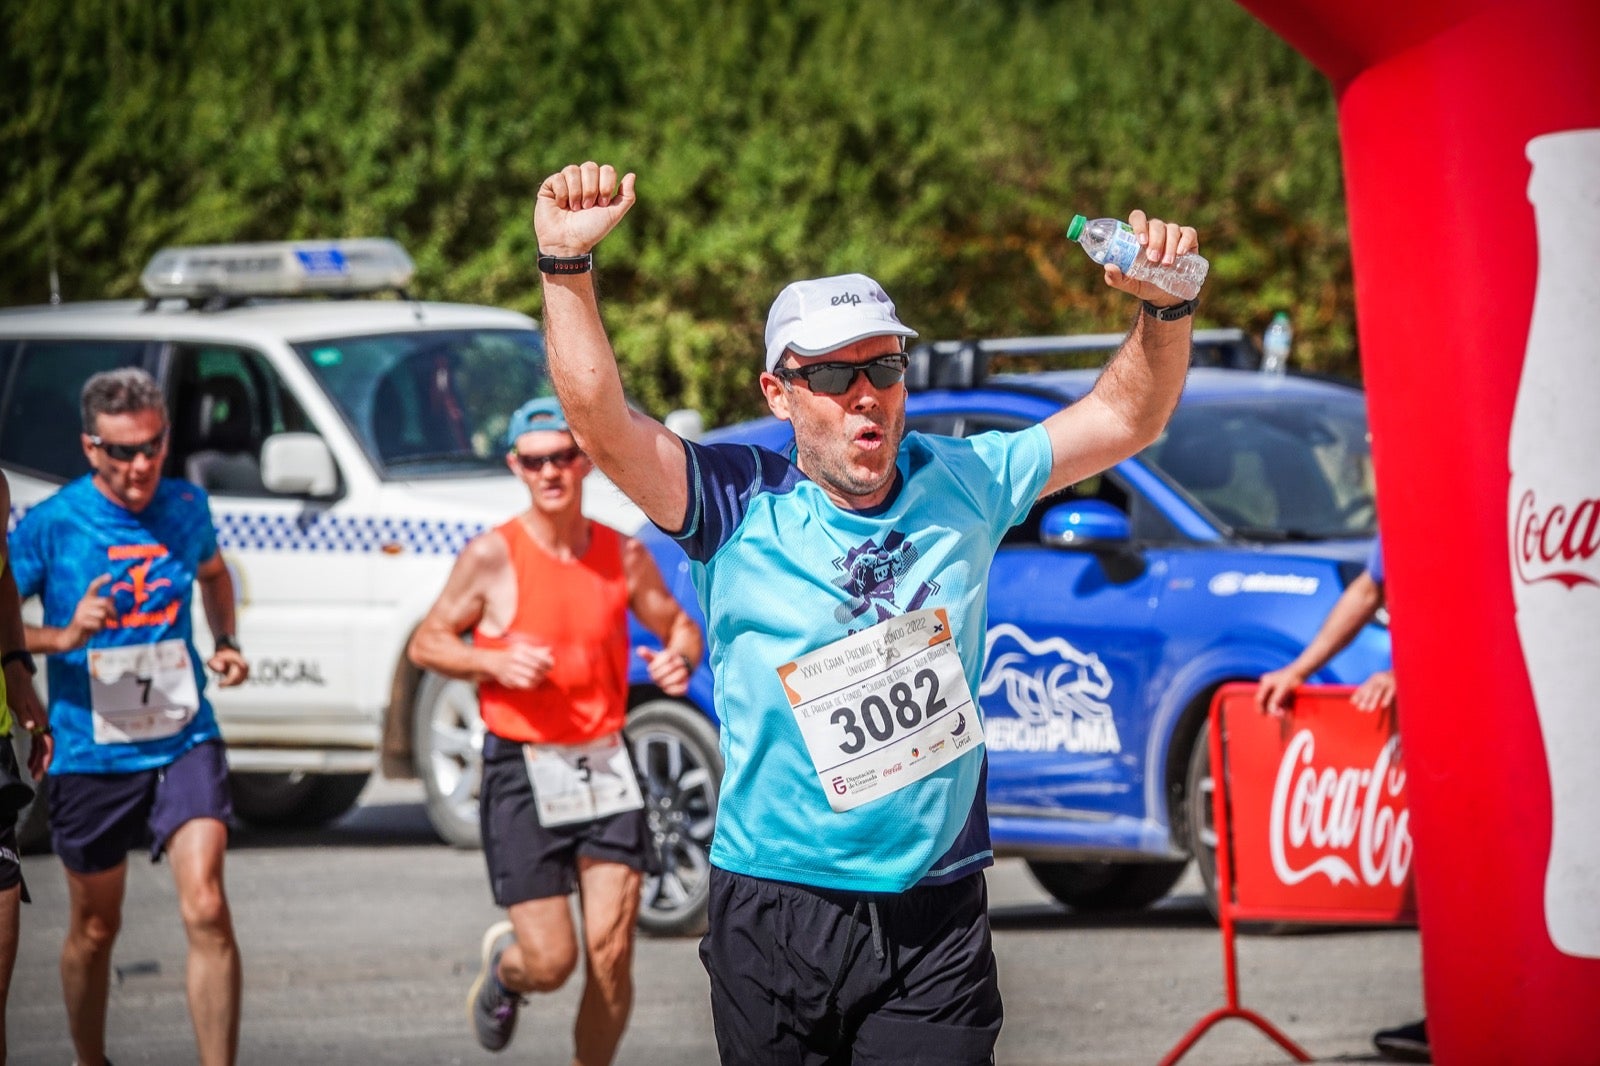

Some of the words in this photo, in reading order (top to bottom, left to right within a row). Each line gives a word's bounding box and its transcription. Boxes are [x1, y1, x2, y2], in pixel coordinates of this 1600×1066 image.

[831, 291, 861, 307] edp
[800, 661, 822, 679] XXXV
[905, 617, 927, 636] 2022
[136, 678, 152, 705] 7
[830, 668, 948, 754] 3082
[577, 755, 591, 783] 5
